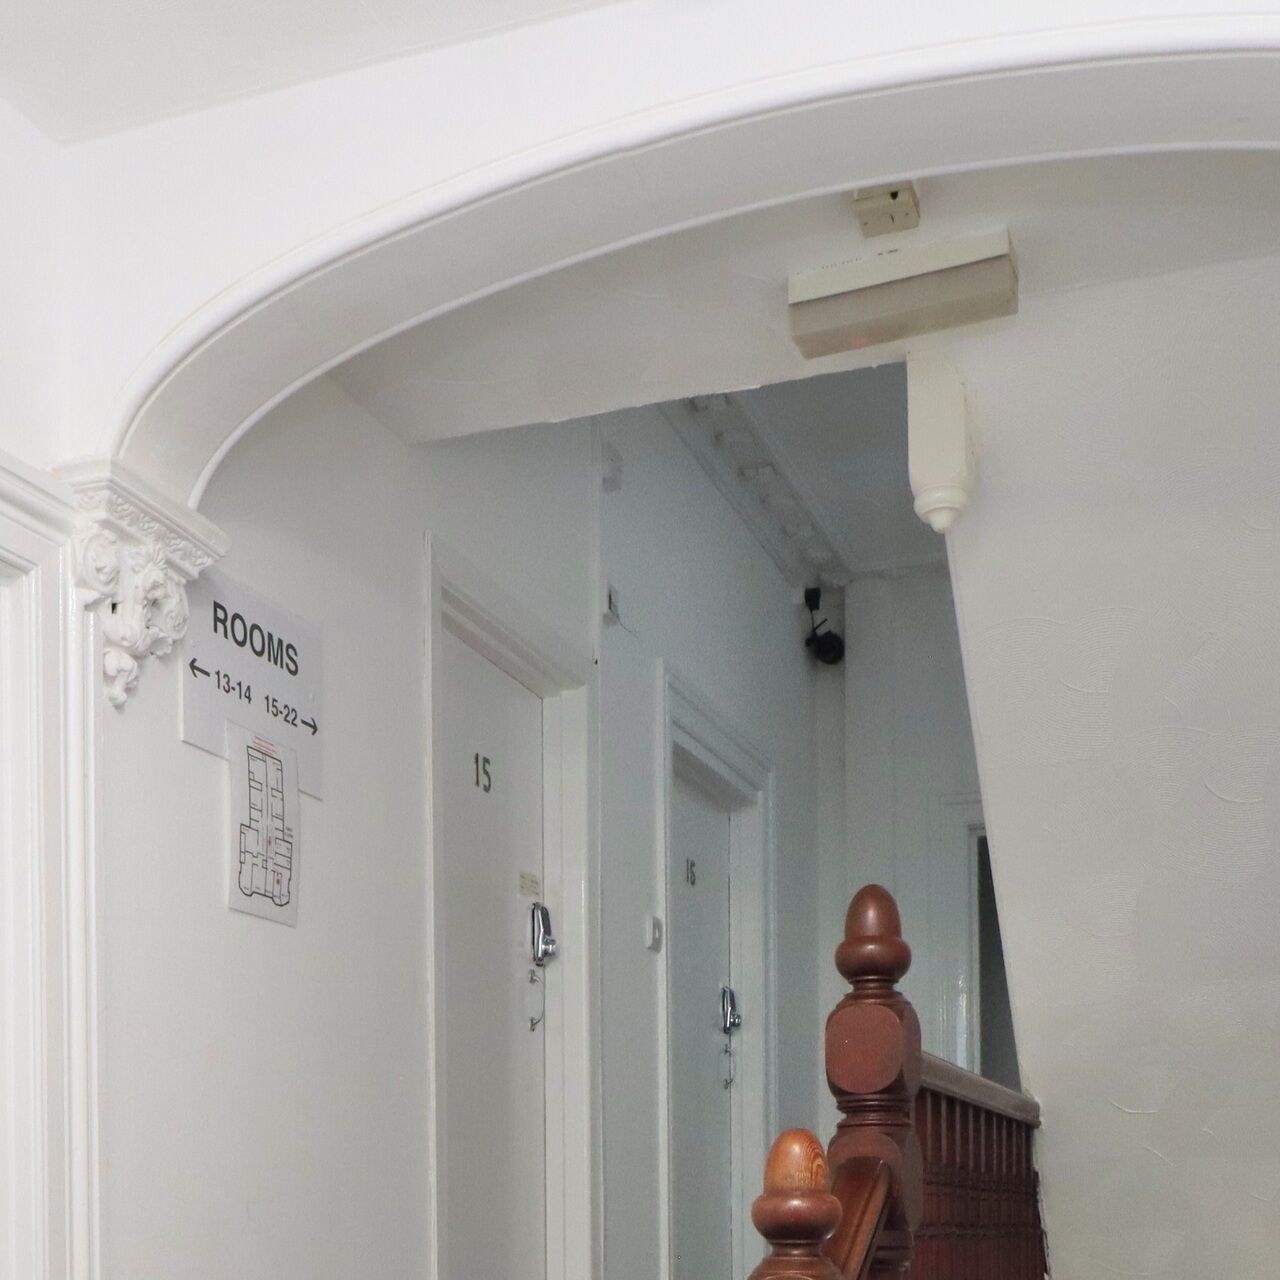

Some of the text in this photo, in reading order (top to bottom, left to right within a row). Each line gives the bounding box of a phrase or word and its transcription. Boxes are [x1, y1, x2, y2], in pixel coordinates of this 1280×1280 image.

[213, 600, 299, 677] ROOMS
[215, 670, 299, 728] 13-14 15-22
[474, 752, 492, 793] 15
